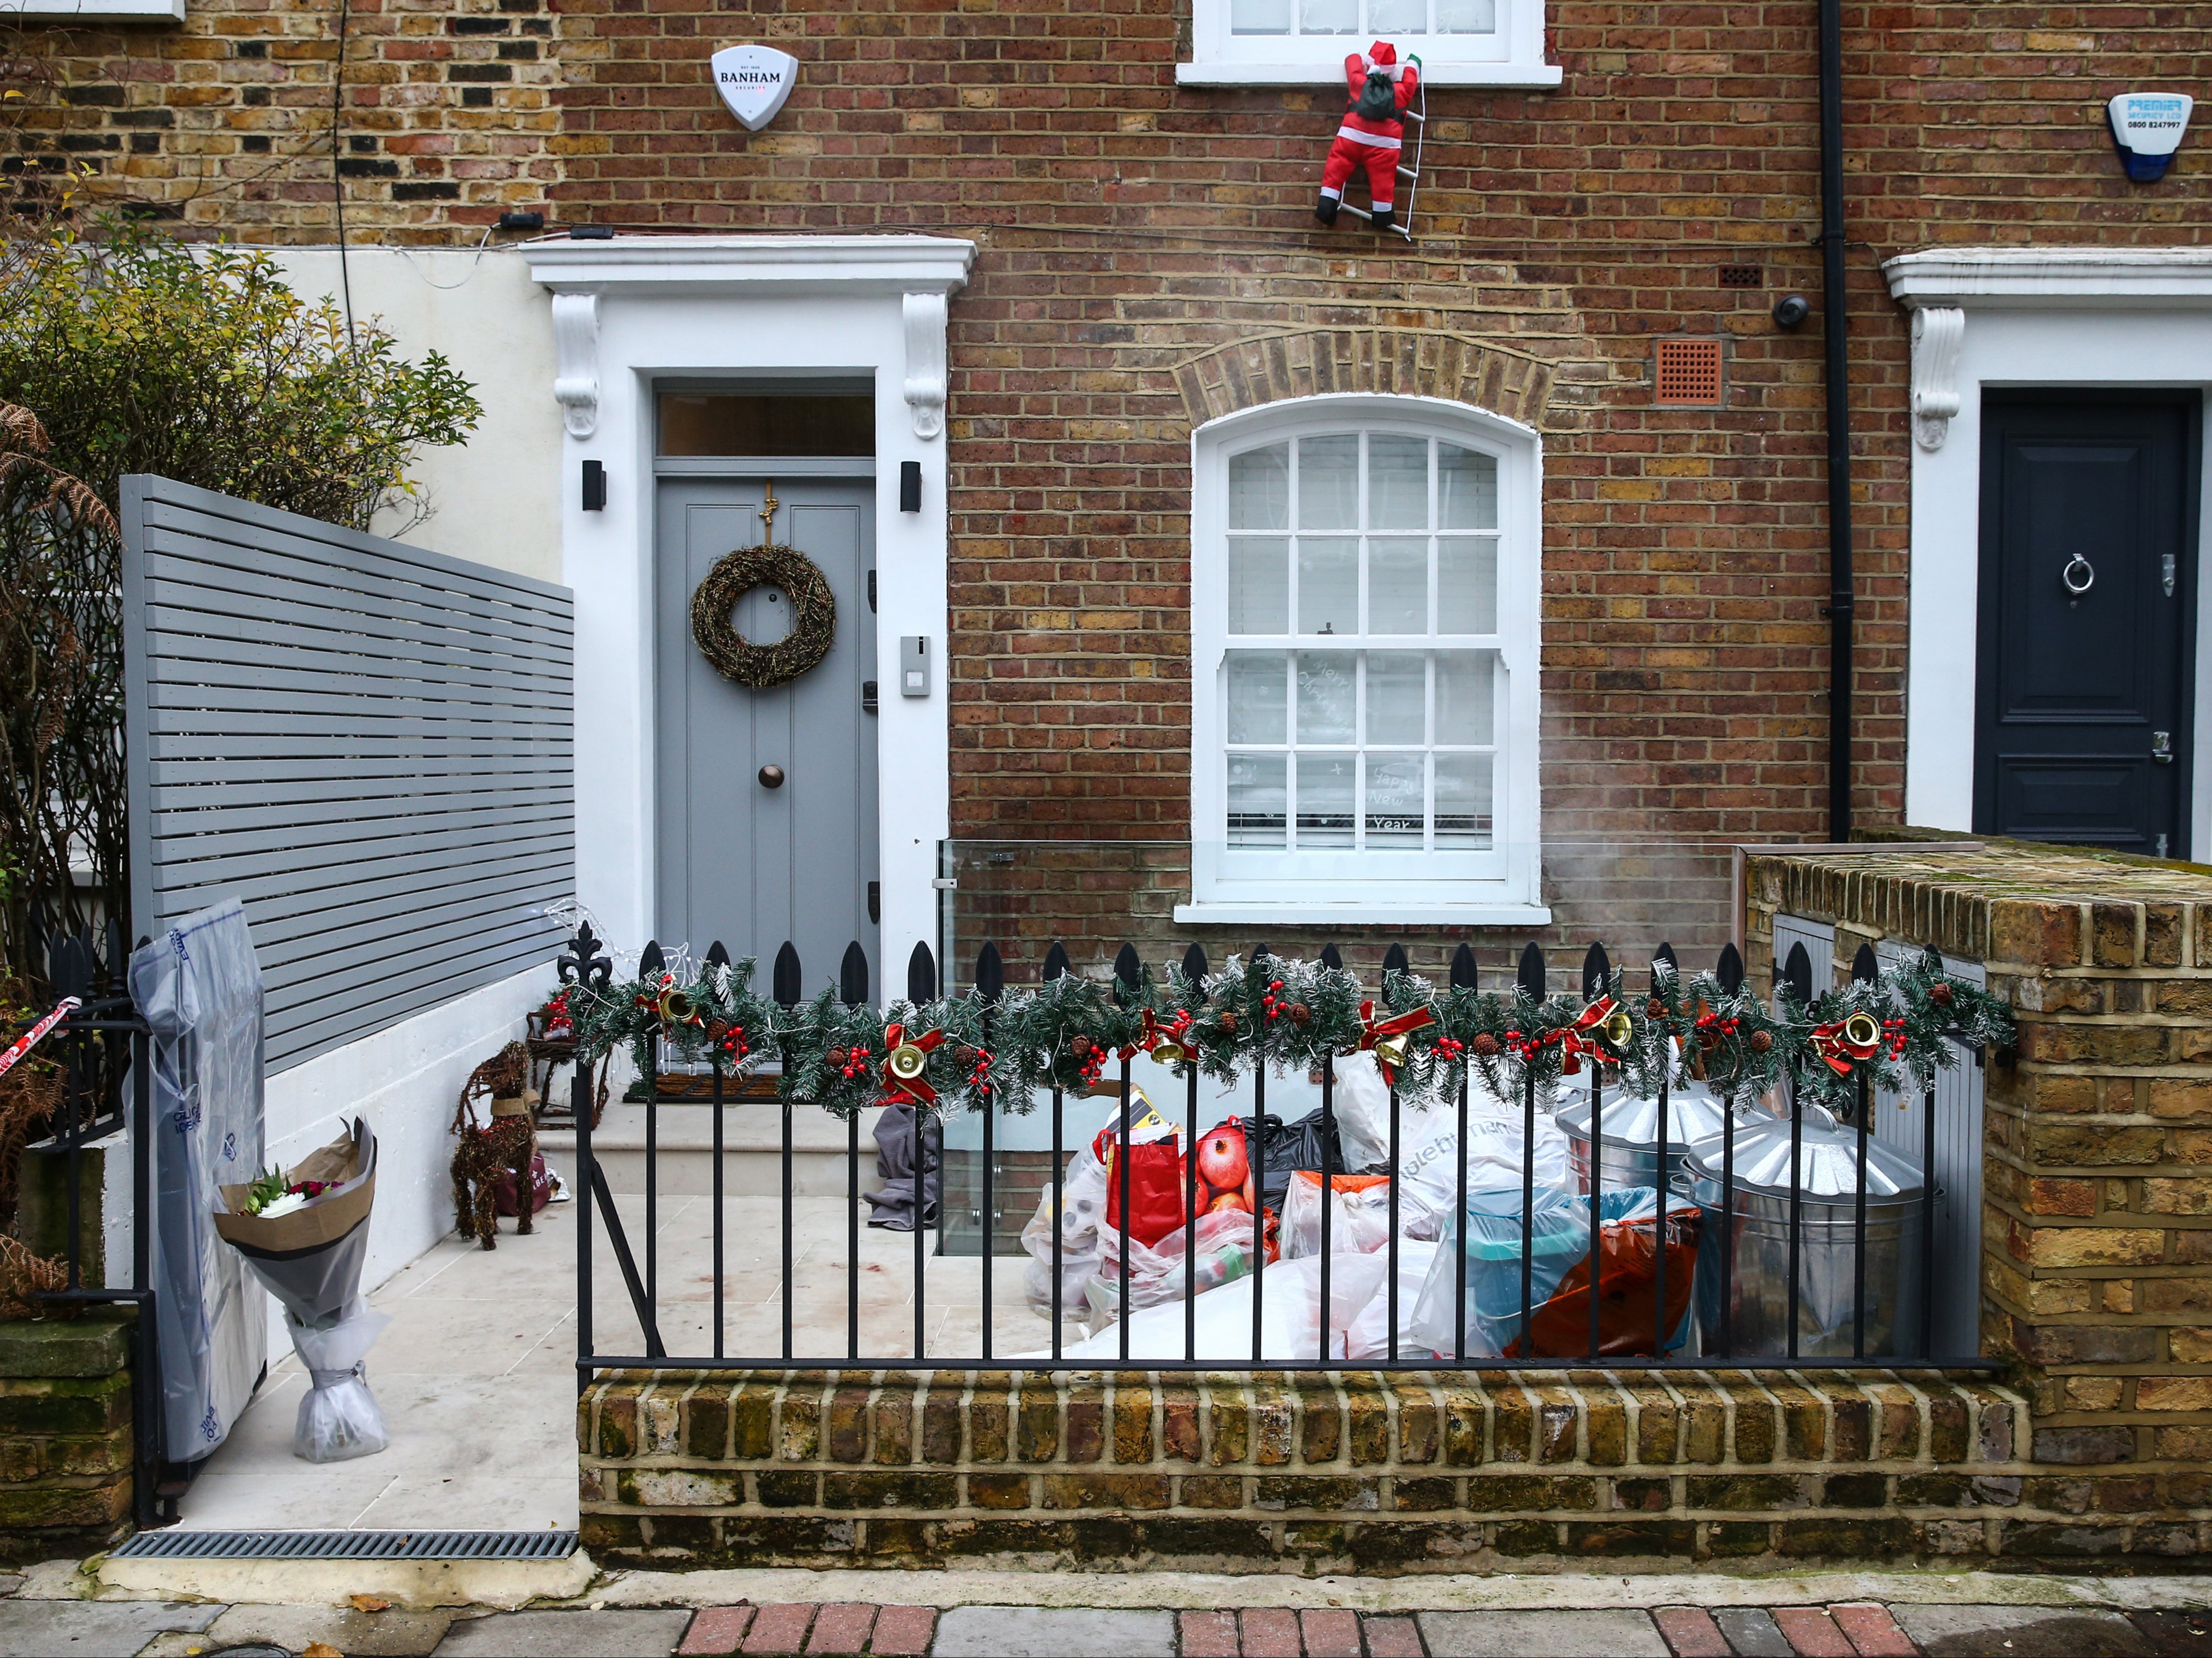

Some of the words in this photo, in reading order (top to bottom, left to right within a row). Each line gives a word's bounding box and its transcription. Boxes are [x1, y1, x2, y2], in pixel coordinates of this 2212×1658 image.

[720, 73, 780, 82] BANHAM
[1374, 767, 1414, 795] Happy
[1369, 790, 1403, 806] New
[1374, 815, 1410, 830] Year
